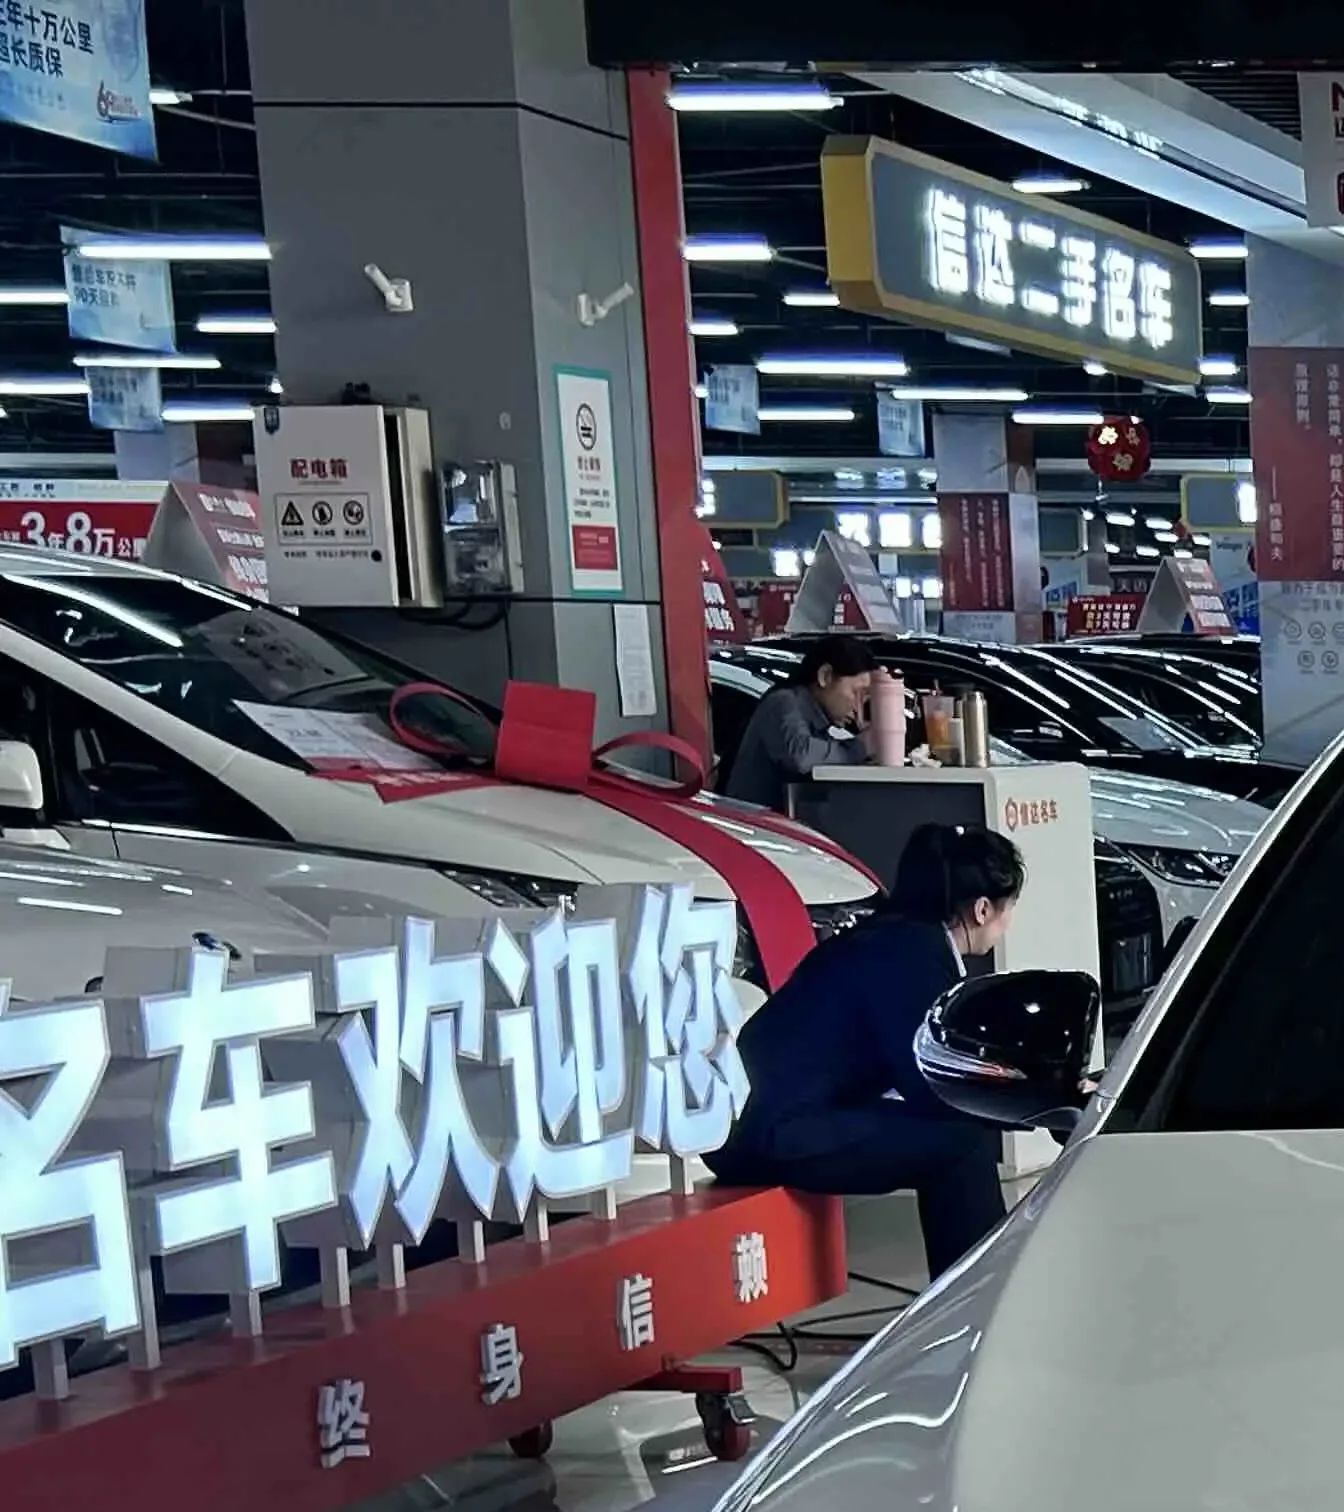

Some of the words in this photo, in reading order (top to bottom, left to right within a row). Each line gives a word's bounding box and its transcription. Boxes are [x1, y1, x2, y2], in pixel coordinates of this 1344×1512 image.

[290, 458, 348, 479] 配电箱
[0, 882, 751, 1372] 名车欢迎您
